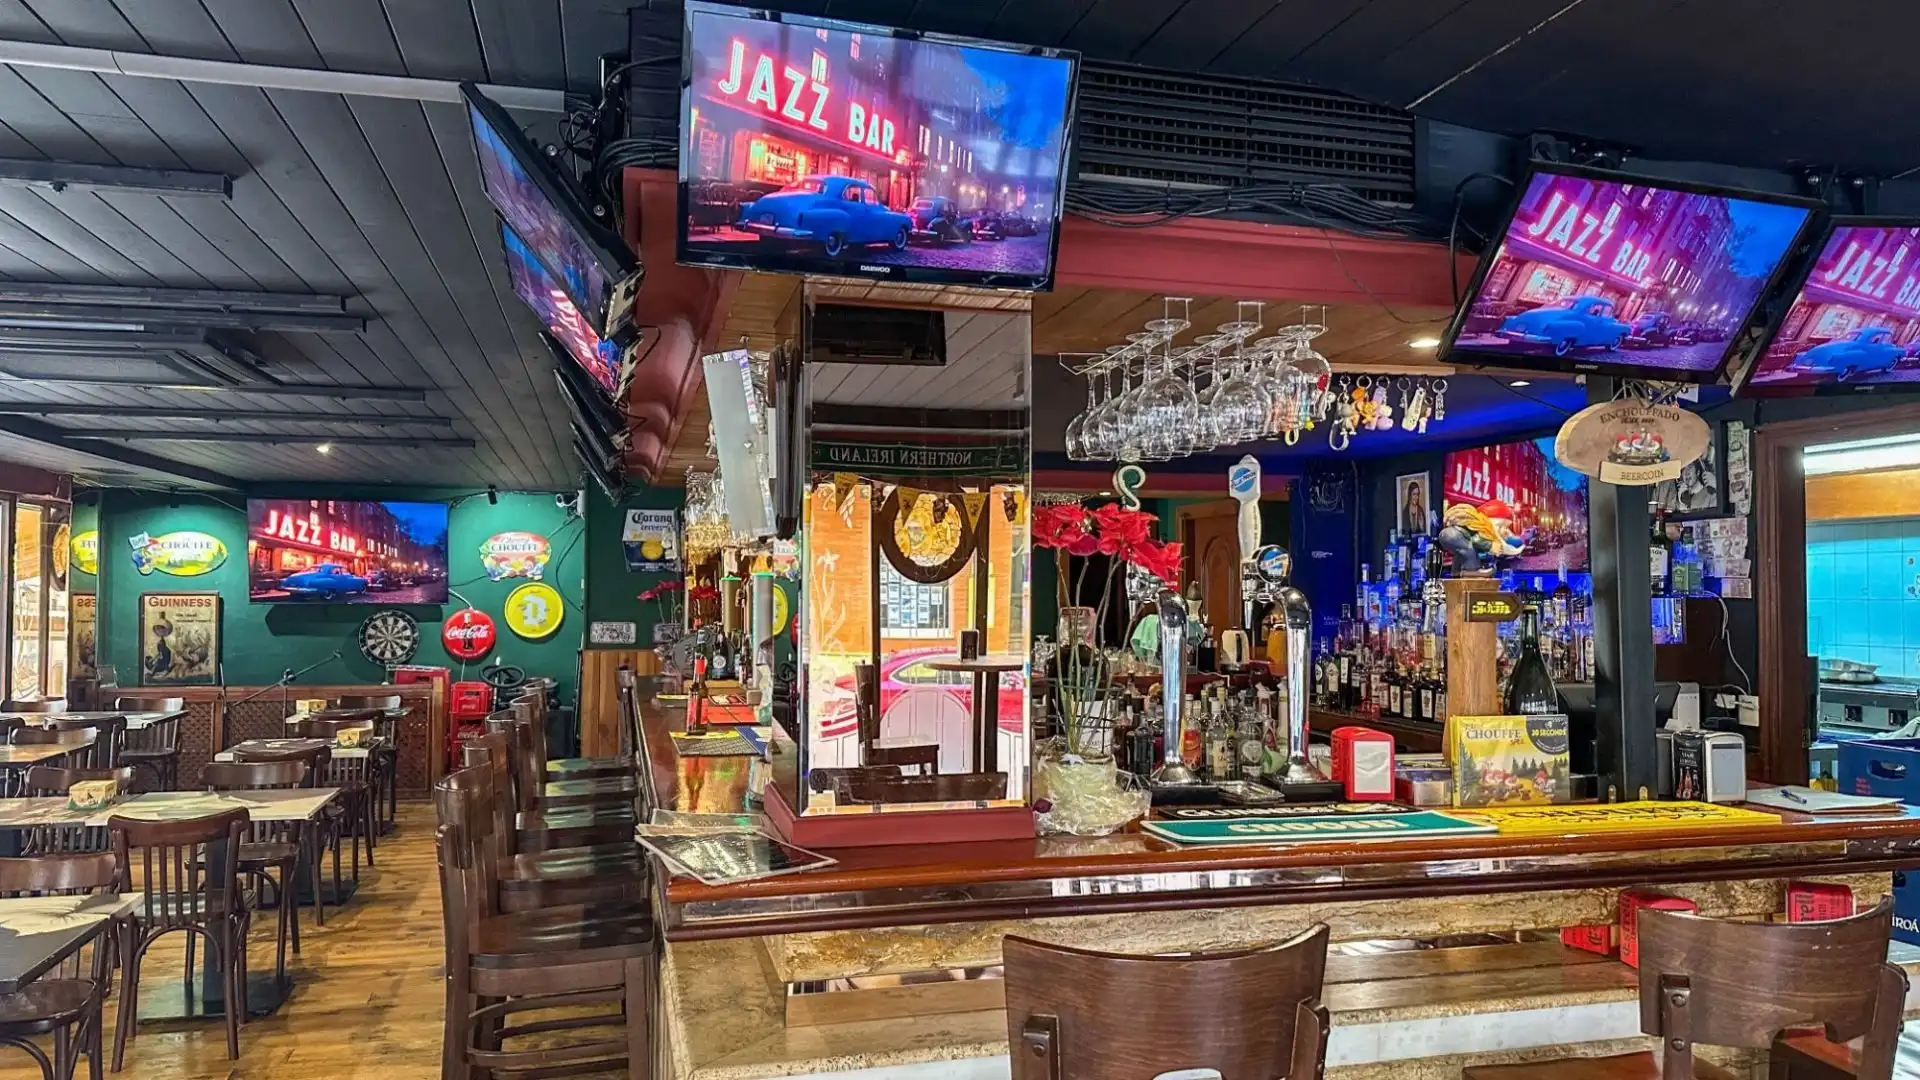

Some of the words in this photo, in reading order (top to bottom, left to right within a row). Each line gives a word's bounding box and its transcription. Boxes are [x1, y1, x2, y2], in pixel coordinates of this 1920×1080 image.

[718, 40, 830, 130] JAZZ
[848, 101, 895, 155] BAR
[1528, 191, 1614, 263] JAZZ
[1611, 240, 1650, 281] BAR
[860, 265, 891, 273] DAEWOO
[1825, 241, 1899, 299] JAZZ
[1453, 463, 1490, 500] JAZZ
[1620, 469, 1664, 480] BEERCOIN
[631, 511, 673, 525] Corona
[264, 509, 322, 546] JAZZ
[330, 531, 355, 553] BAR
[148, 596, 212, 607] GUINNESS
[1466, 728, 1521, 740] CHOUFFE
